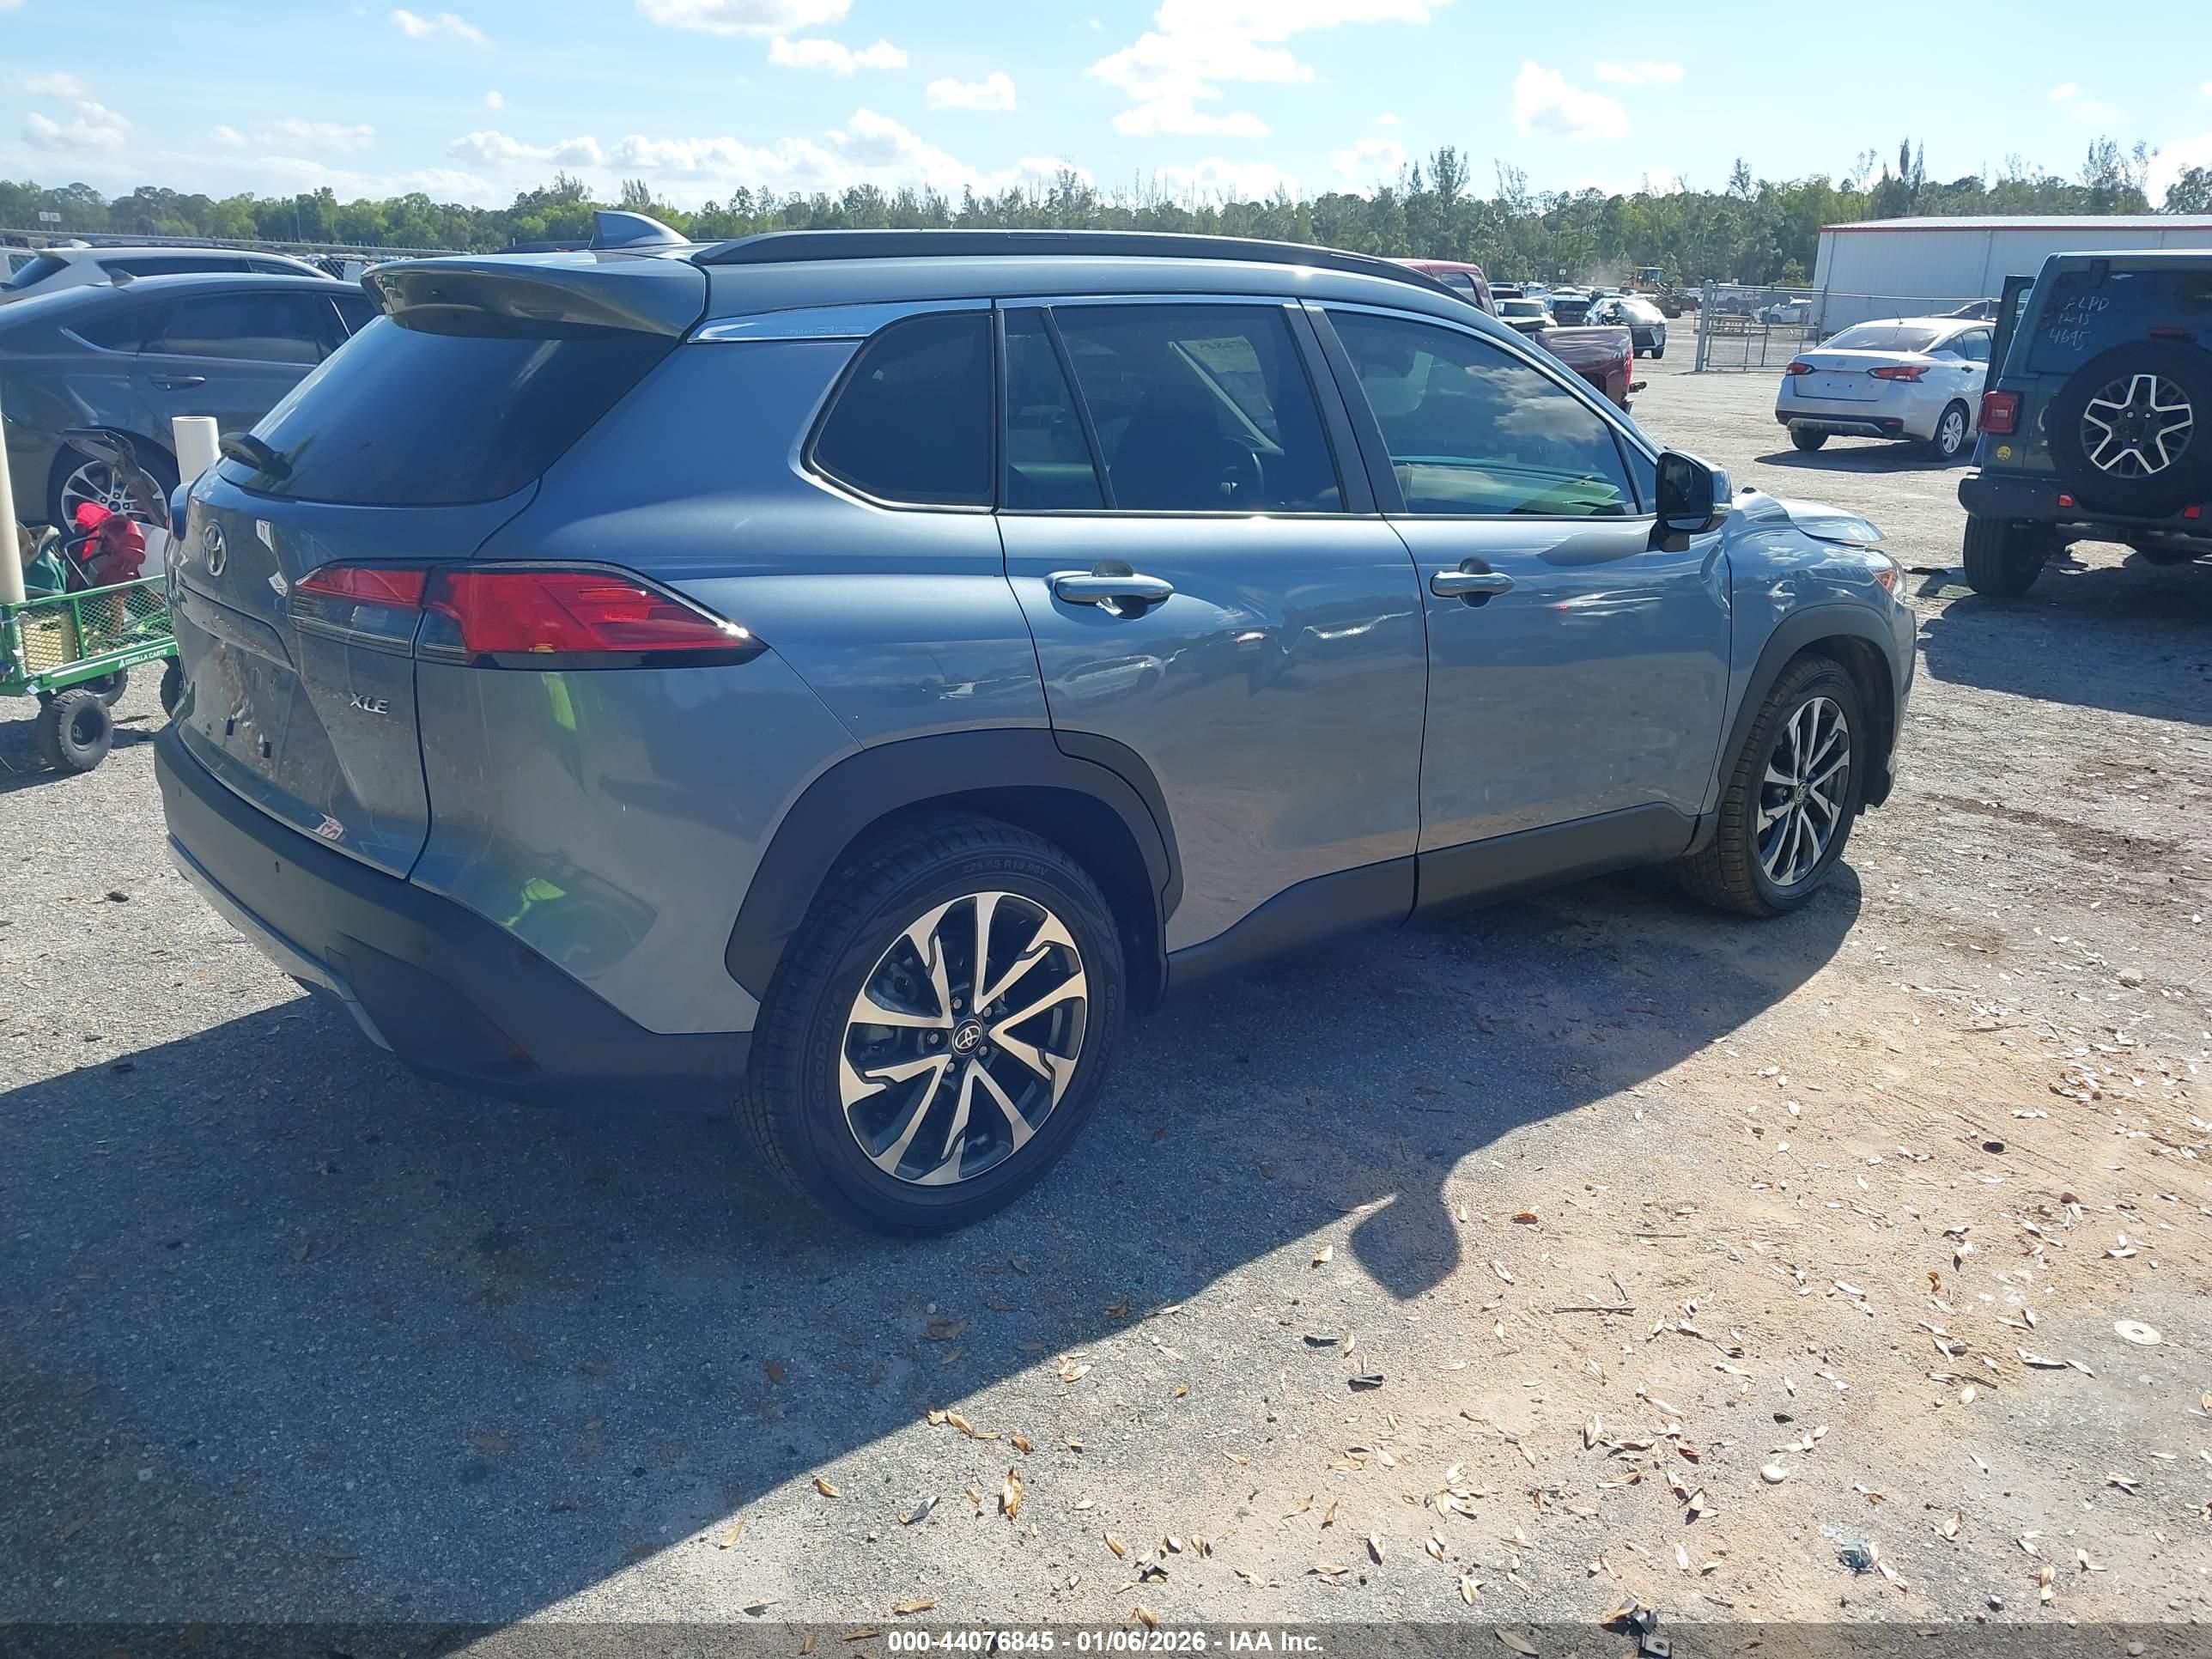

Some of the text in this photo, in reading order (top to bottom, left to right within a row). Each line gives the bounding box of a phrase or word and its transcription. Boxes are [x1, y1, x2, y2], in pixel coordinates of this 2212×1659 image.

[2048, 328, 2092, 351] 4695
[125, 653, 149, 665] GORILLA
[349, 693, 389, 714] XLE
